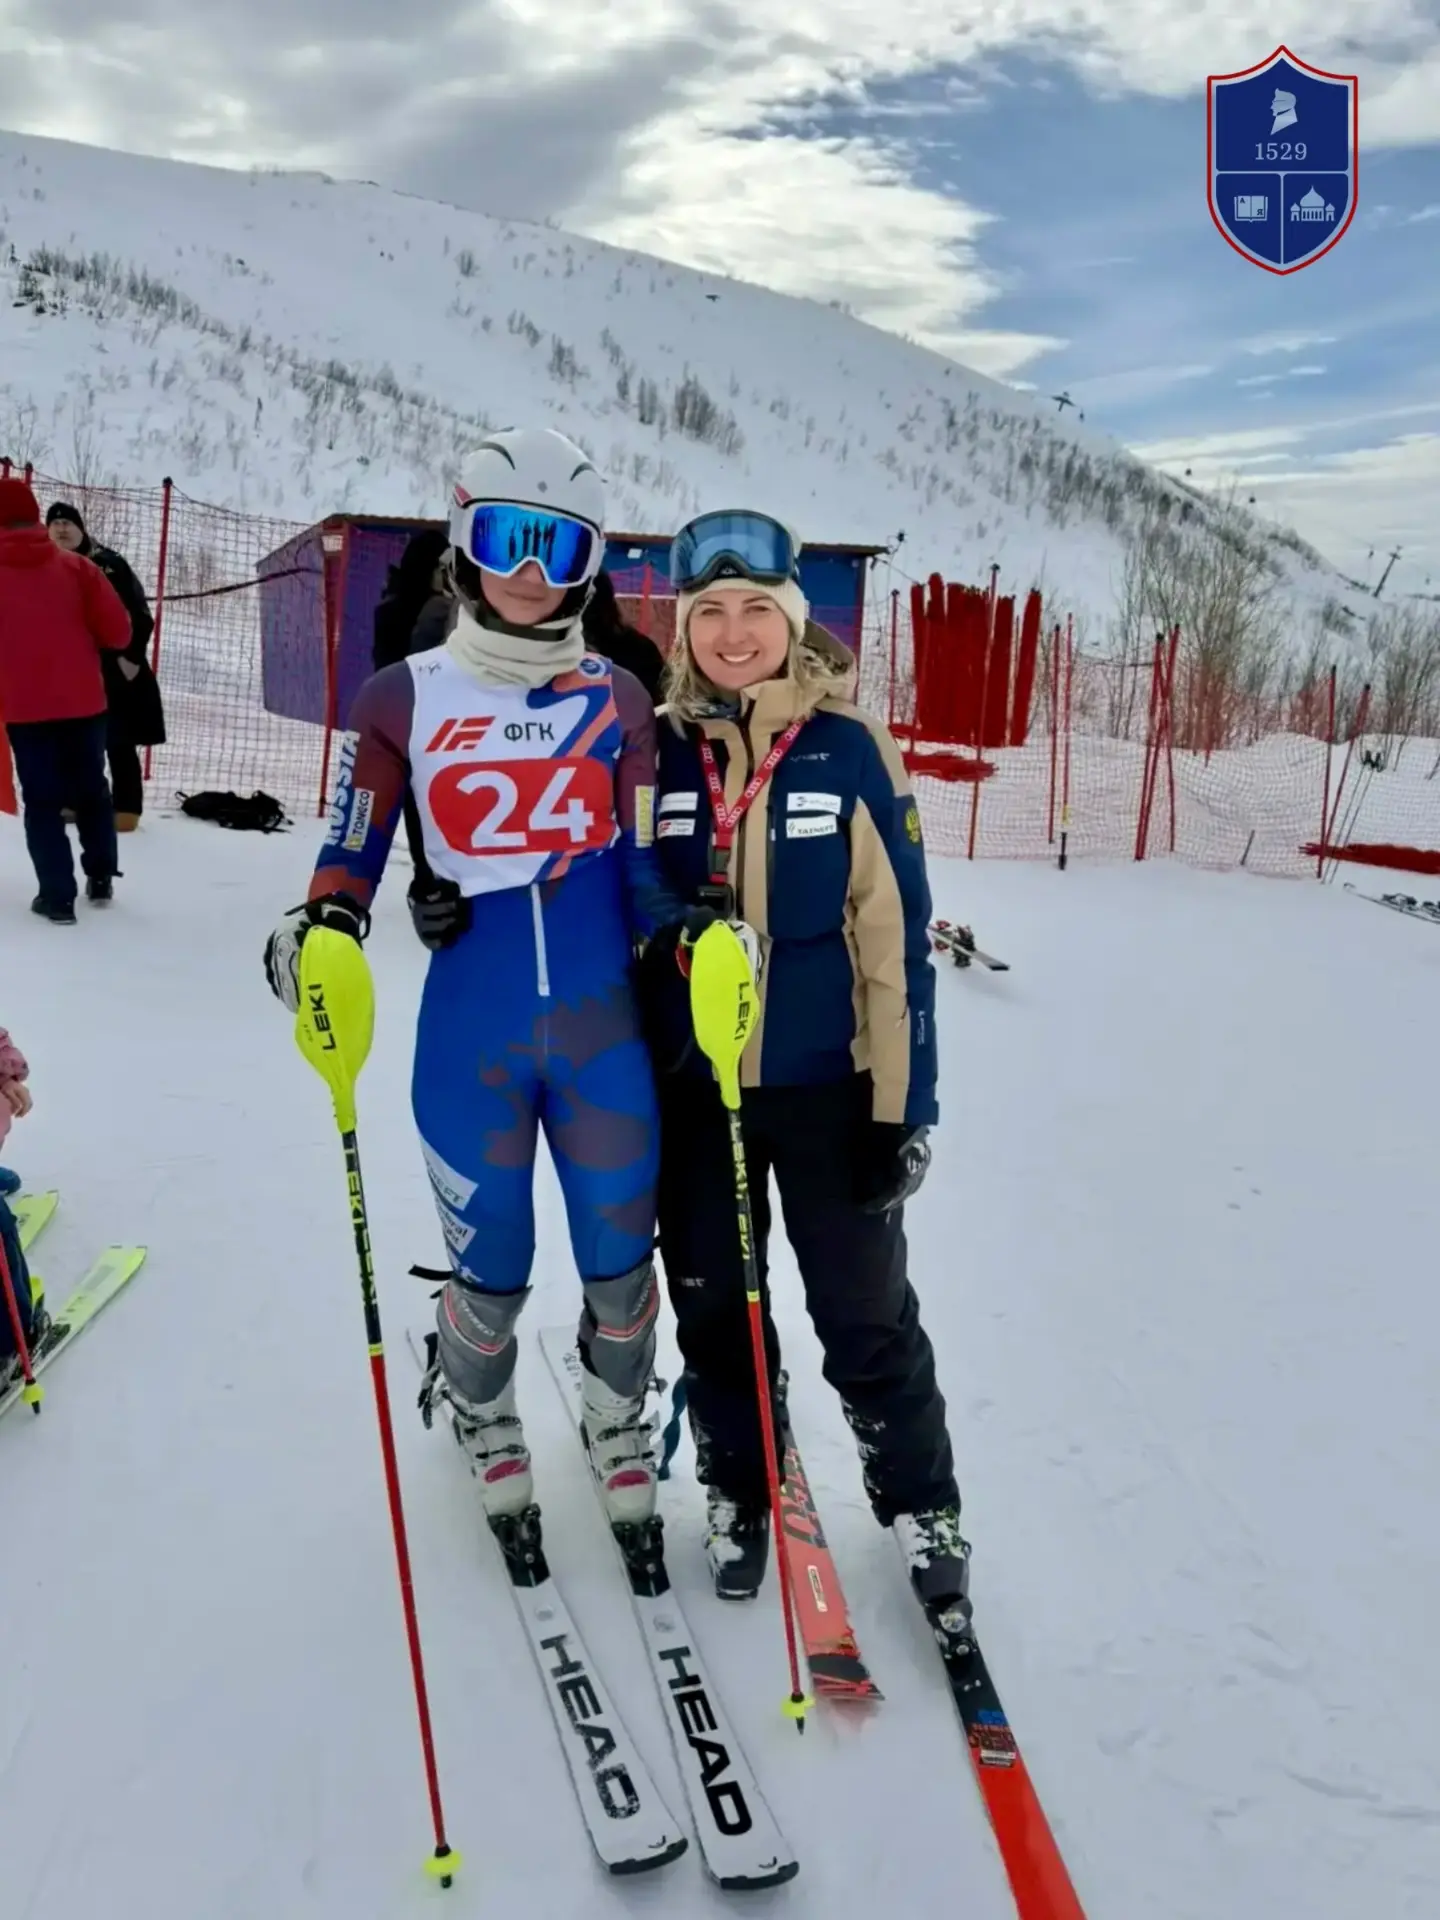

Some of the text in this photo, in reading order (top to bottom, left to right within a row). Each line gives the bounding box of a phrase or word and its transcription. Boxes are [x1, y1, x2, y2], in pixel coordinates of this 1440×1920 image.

[504, 722, 556, 742] ФГК
[456, 767, 595, 849] 24
[308, 983, 337, 1051] LEKI
[735, 981, 750, 1041] LEKI
[540, 1634, 641, 1819] HEAD
[658, 1645, 752, 1836] HEAD
